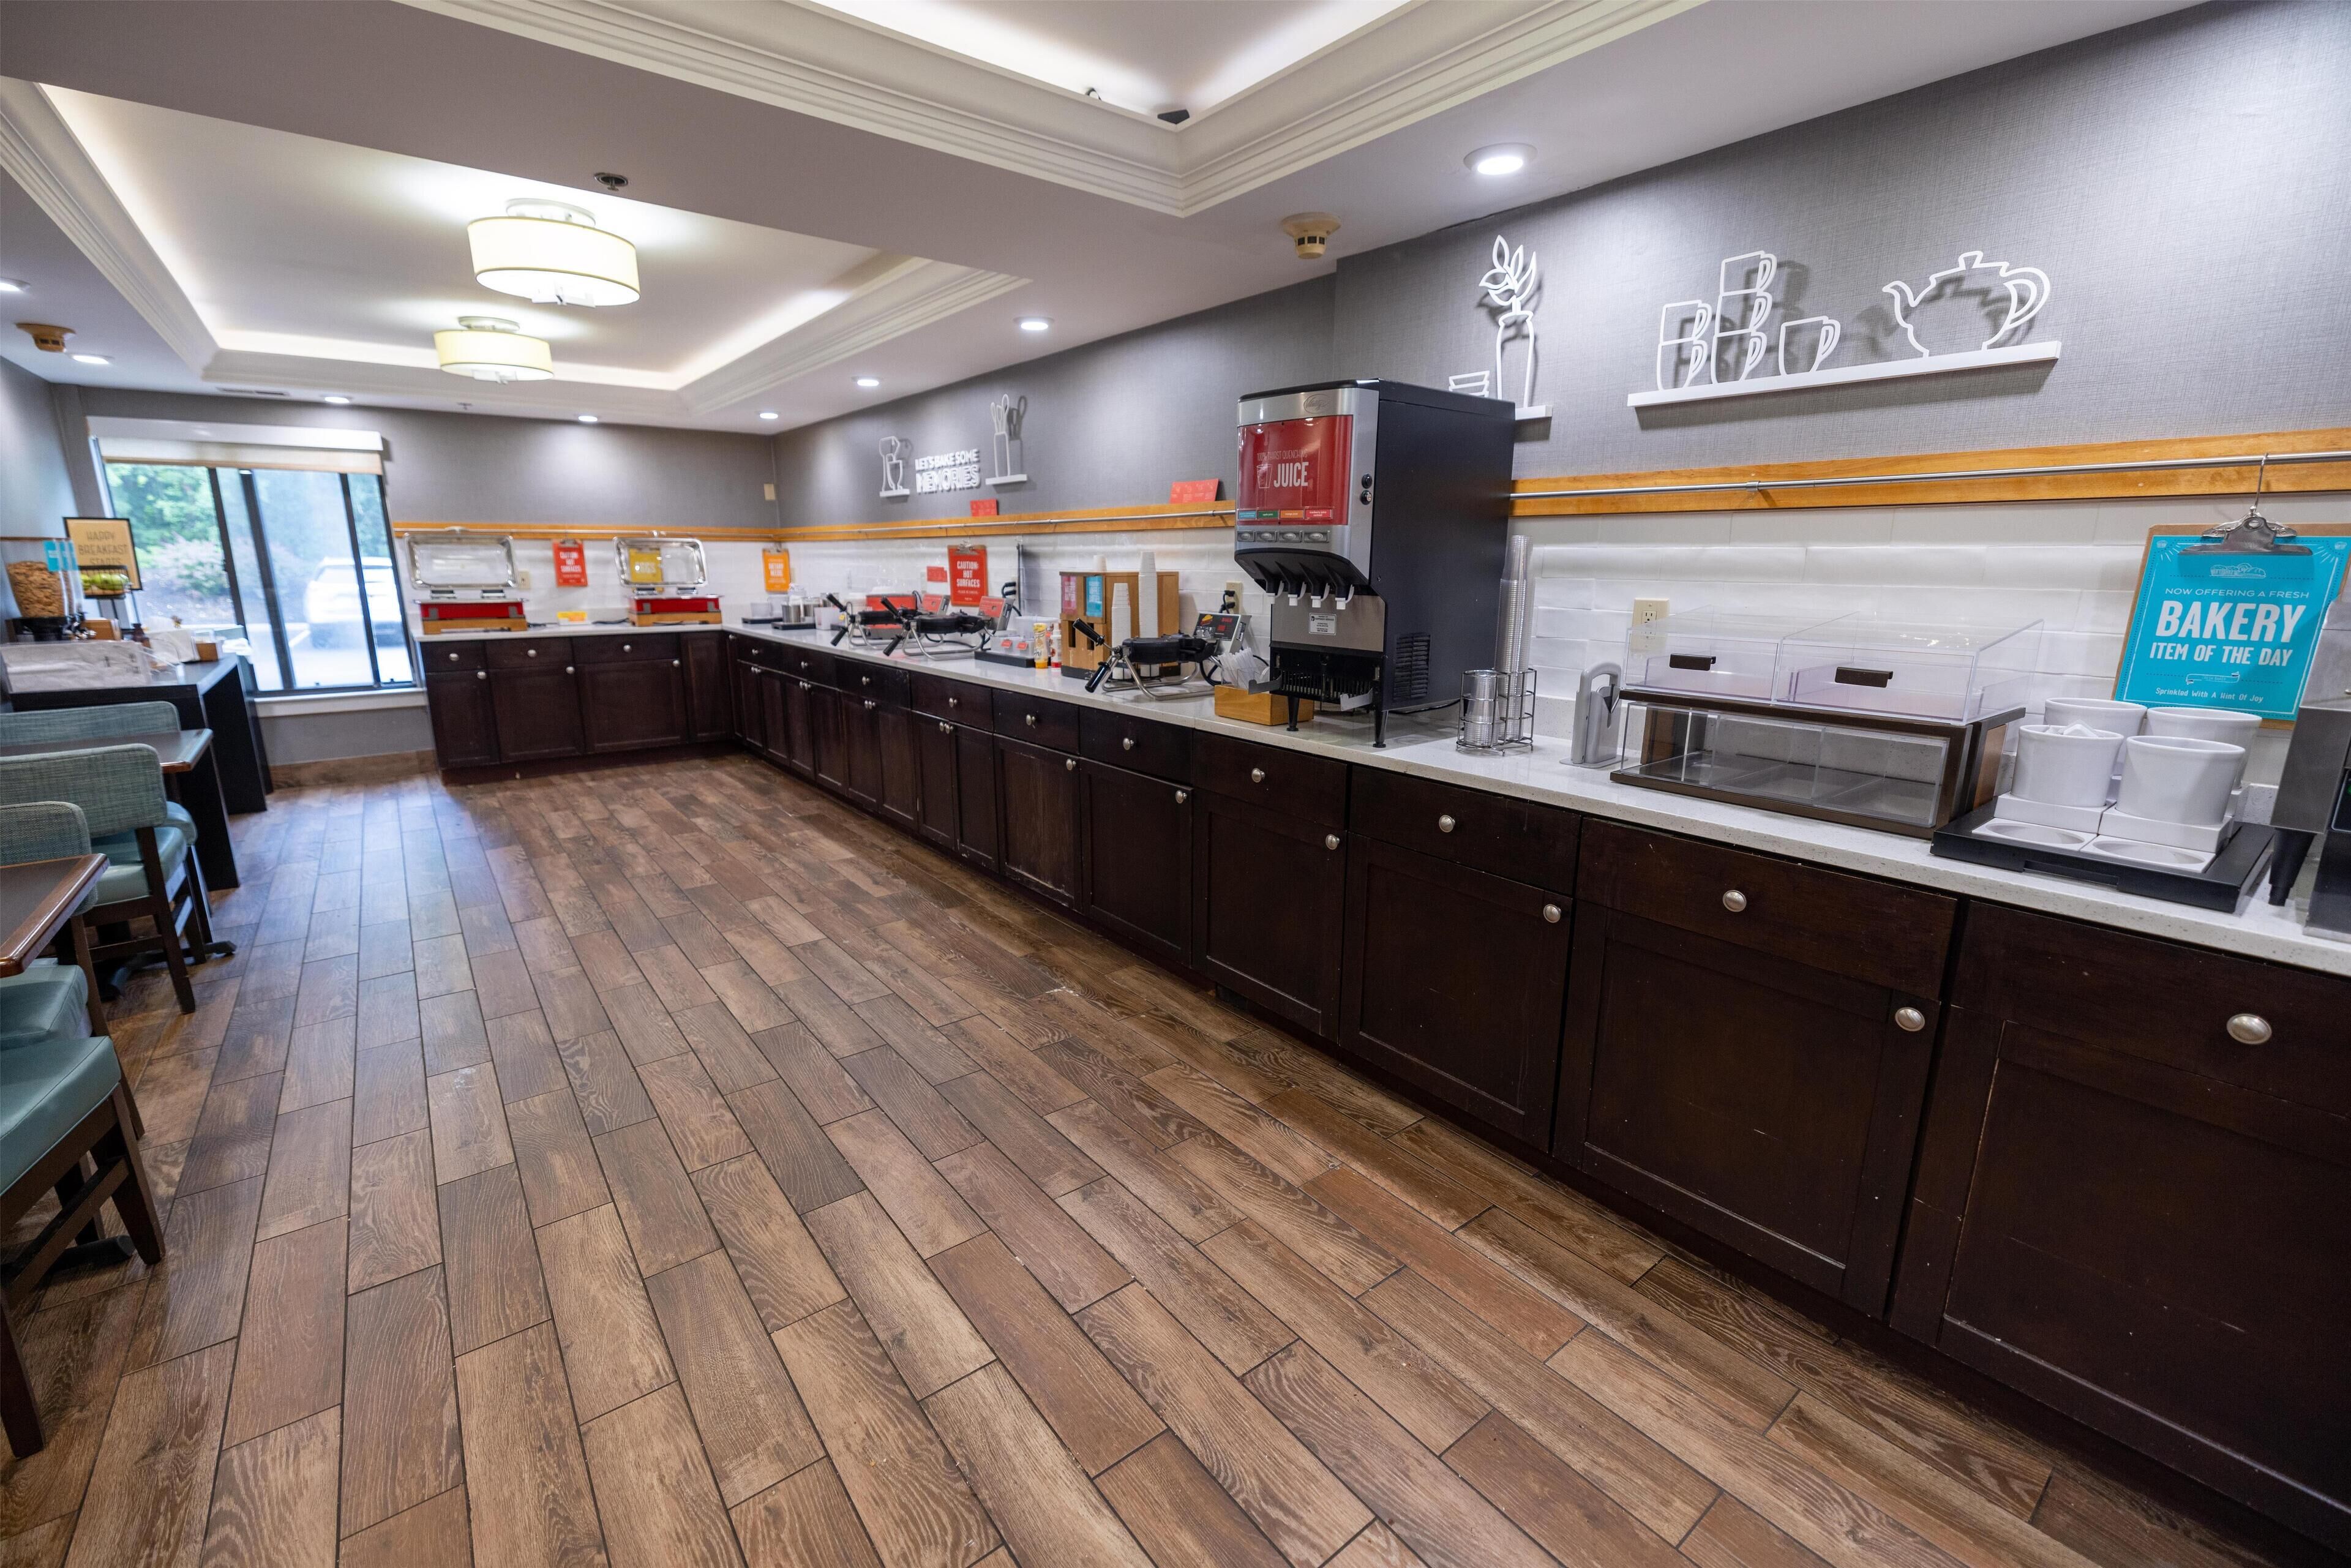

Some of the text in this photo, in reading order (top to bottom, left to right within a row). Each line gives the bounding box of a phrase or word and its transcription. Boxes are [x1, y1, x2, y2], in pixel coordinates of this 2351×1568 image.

[934, 453, 955, 468] BAKE
[955, 448, 980, 465] SOME
[1267, 450, 1282, 460] THIRST
[1283, 449, 1308, 459] QUENCHING
[915, 464, 980, 493] MEMORIES
[1273, 462, 1309, 487] JUICE
[87, 531, 114, 539] HAPPY
[78, 544, 128, 555] BREAKFAST
[957, 561, 978, 569] CAUTION:
[956, 579, 980, 587] SURFACES
[2195, 588, 2255, 597] OFFERING
[2155, 600, 2307, 643] BAKERY
[2150, 642, 2293, 667] ITEM OF THE DAY
[2155, 688, 2189, 697] Sprinkled
[2191, 689, 2208, 698] With
[2220, 691, 2236, 700] Hint
[2249, 694, 2264, 703] Joy
